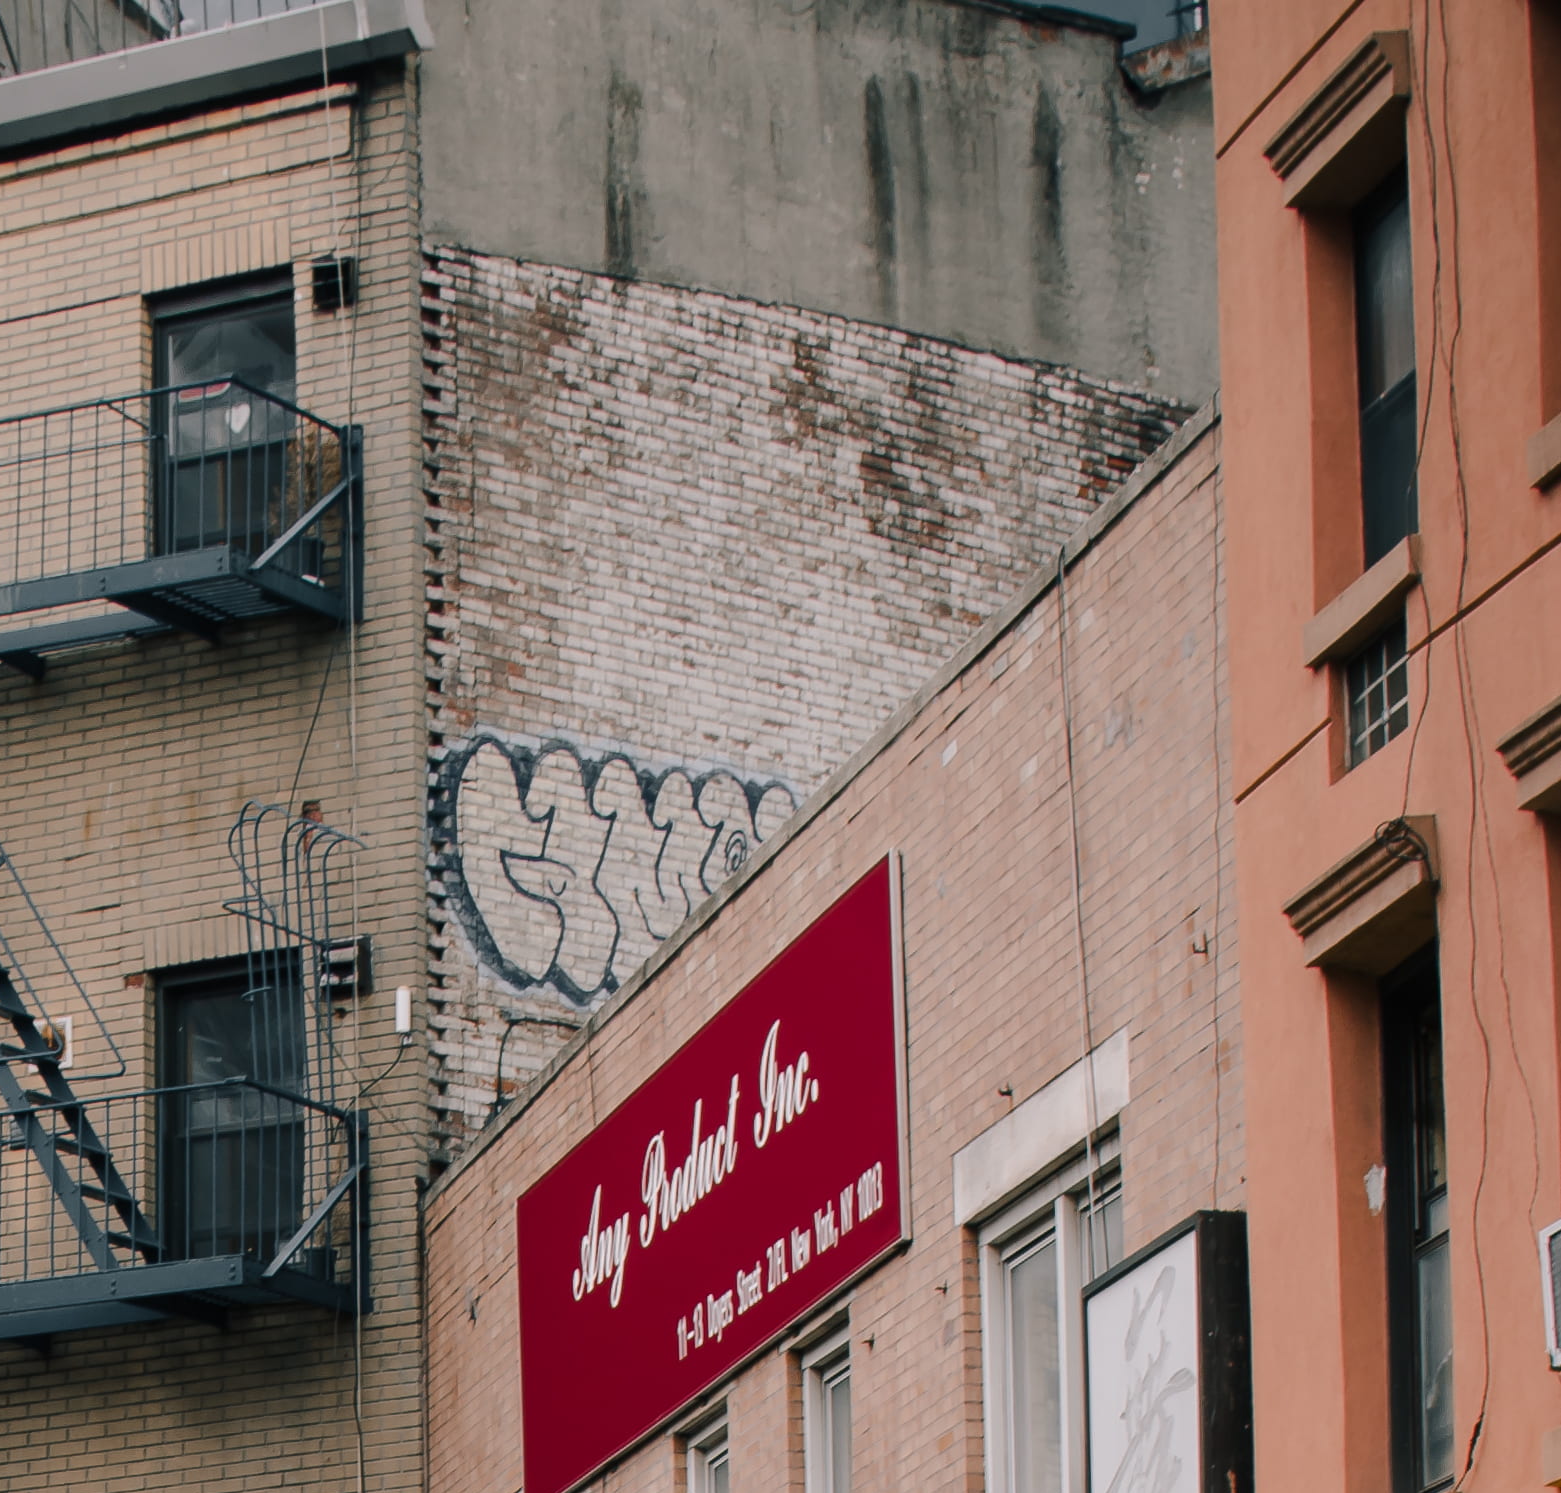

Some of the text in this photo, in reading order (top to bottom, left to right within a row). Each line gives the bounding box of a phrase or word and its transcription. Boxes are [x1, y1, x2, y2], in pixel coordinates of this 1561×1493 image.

[572, 1018, 820, 1309] Any Product Inc.
[737, 1260, 763, 1316] Street
[791, 1226, 811, 1274] New
[840, 1183, 854, 1236] NY
